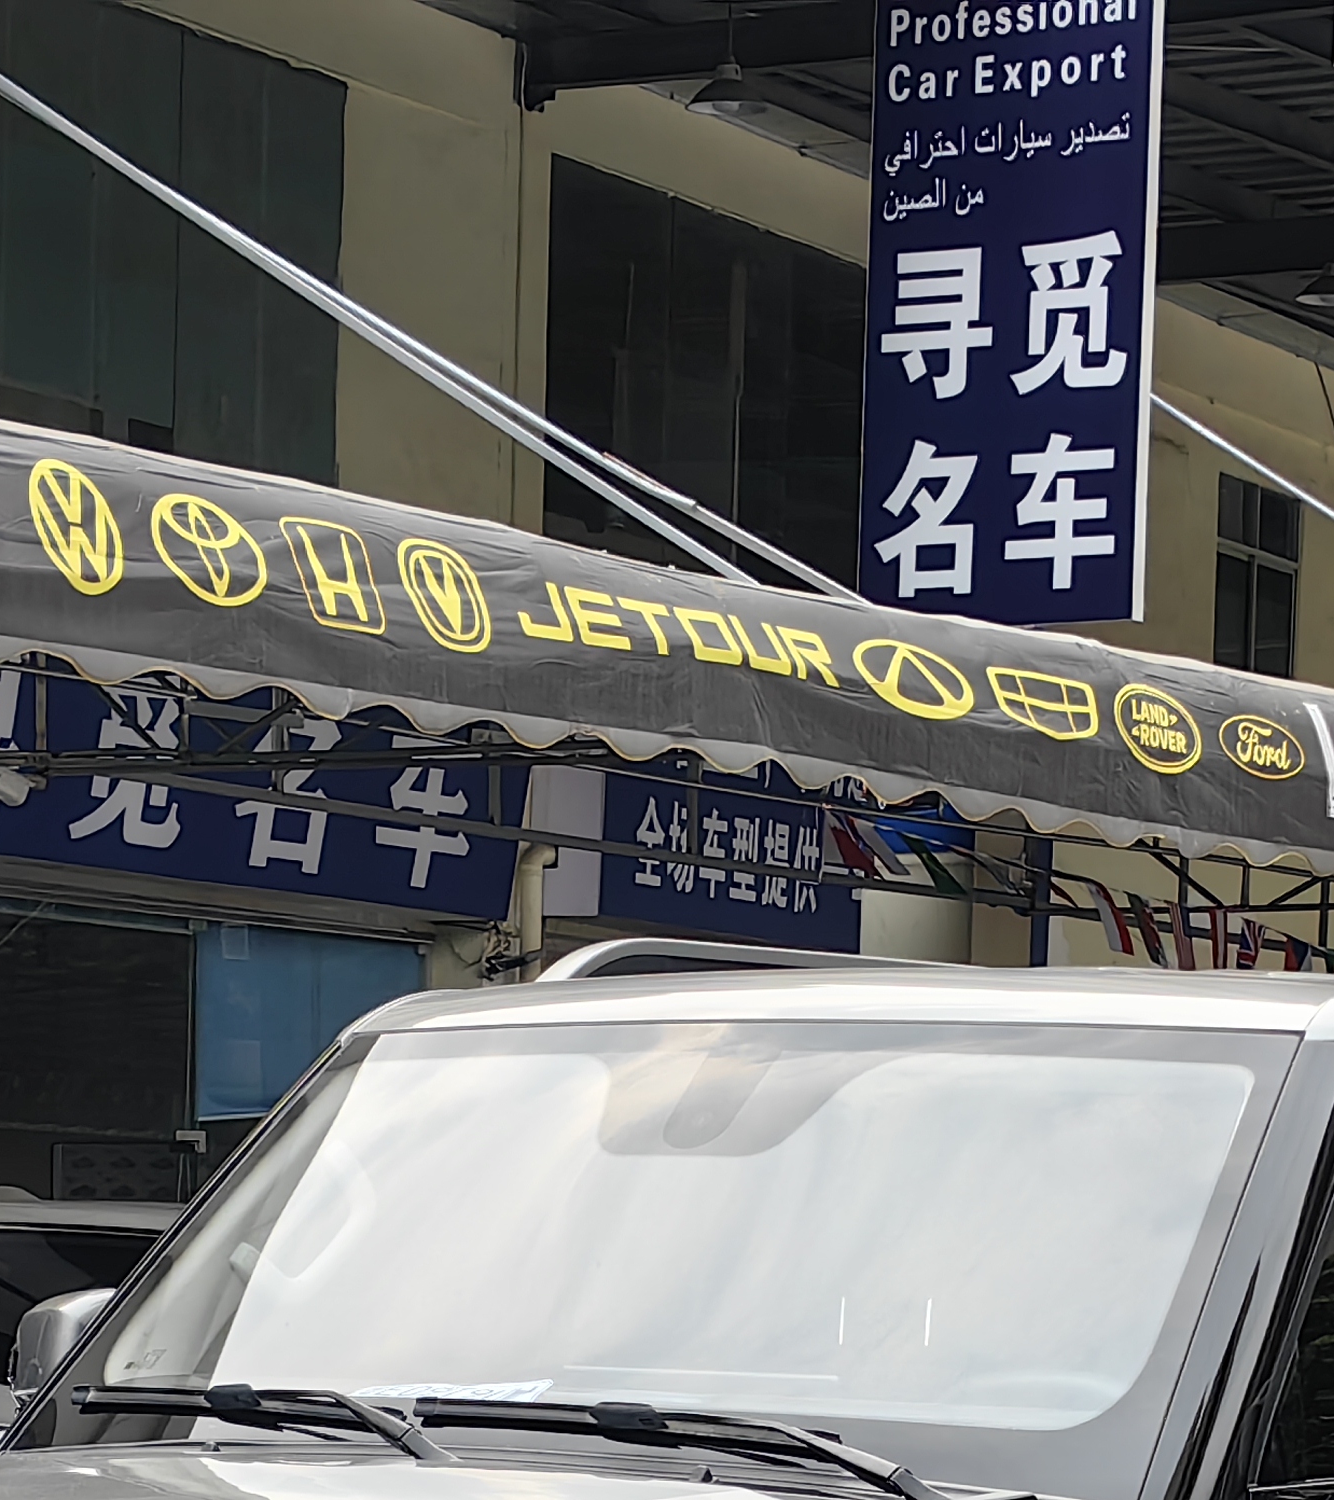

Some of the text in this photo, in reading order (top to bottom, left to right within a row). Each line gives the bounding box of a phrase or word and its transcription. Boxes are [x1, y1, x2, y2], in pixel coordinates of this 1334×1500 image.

[889, 0, 1138, 48] Professional
[887, 43, 1128, 102] Car Export
[883, 112, 1132, 176] تصدير سيارات احترافي
[883, 178, 985, 221] من الصين
[881, 230, 1128, 400] 寻觅
[873, 432, 1117, 599] 名车
[518, 582, 840, 688] JETOUR
[1131, 699, 1170, 728] LAND
[1139, 726, 1187, 755] ROVER
[1236, 722, 1292, 770] Ford
[634, 796, 820, 914] 全场车型提供
